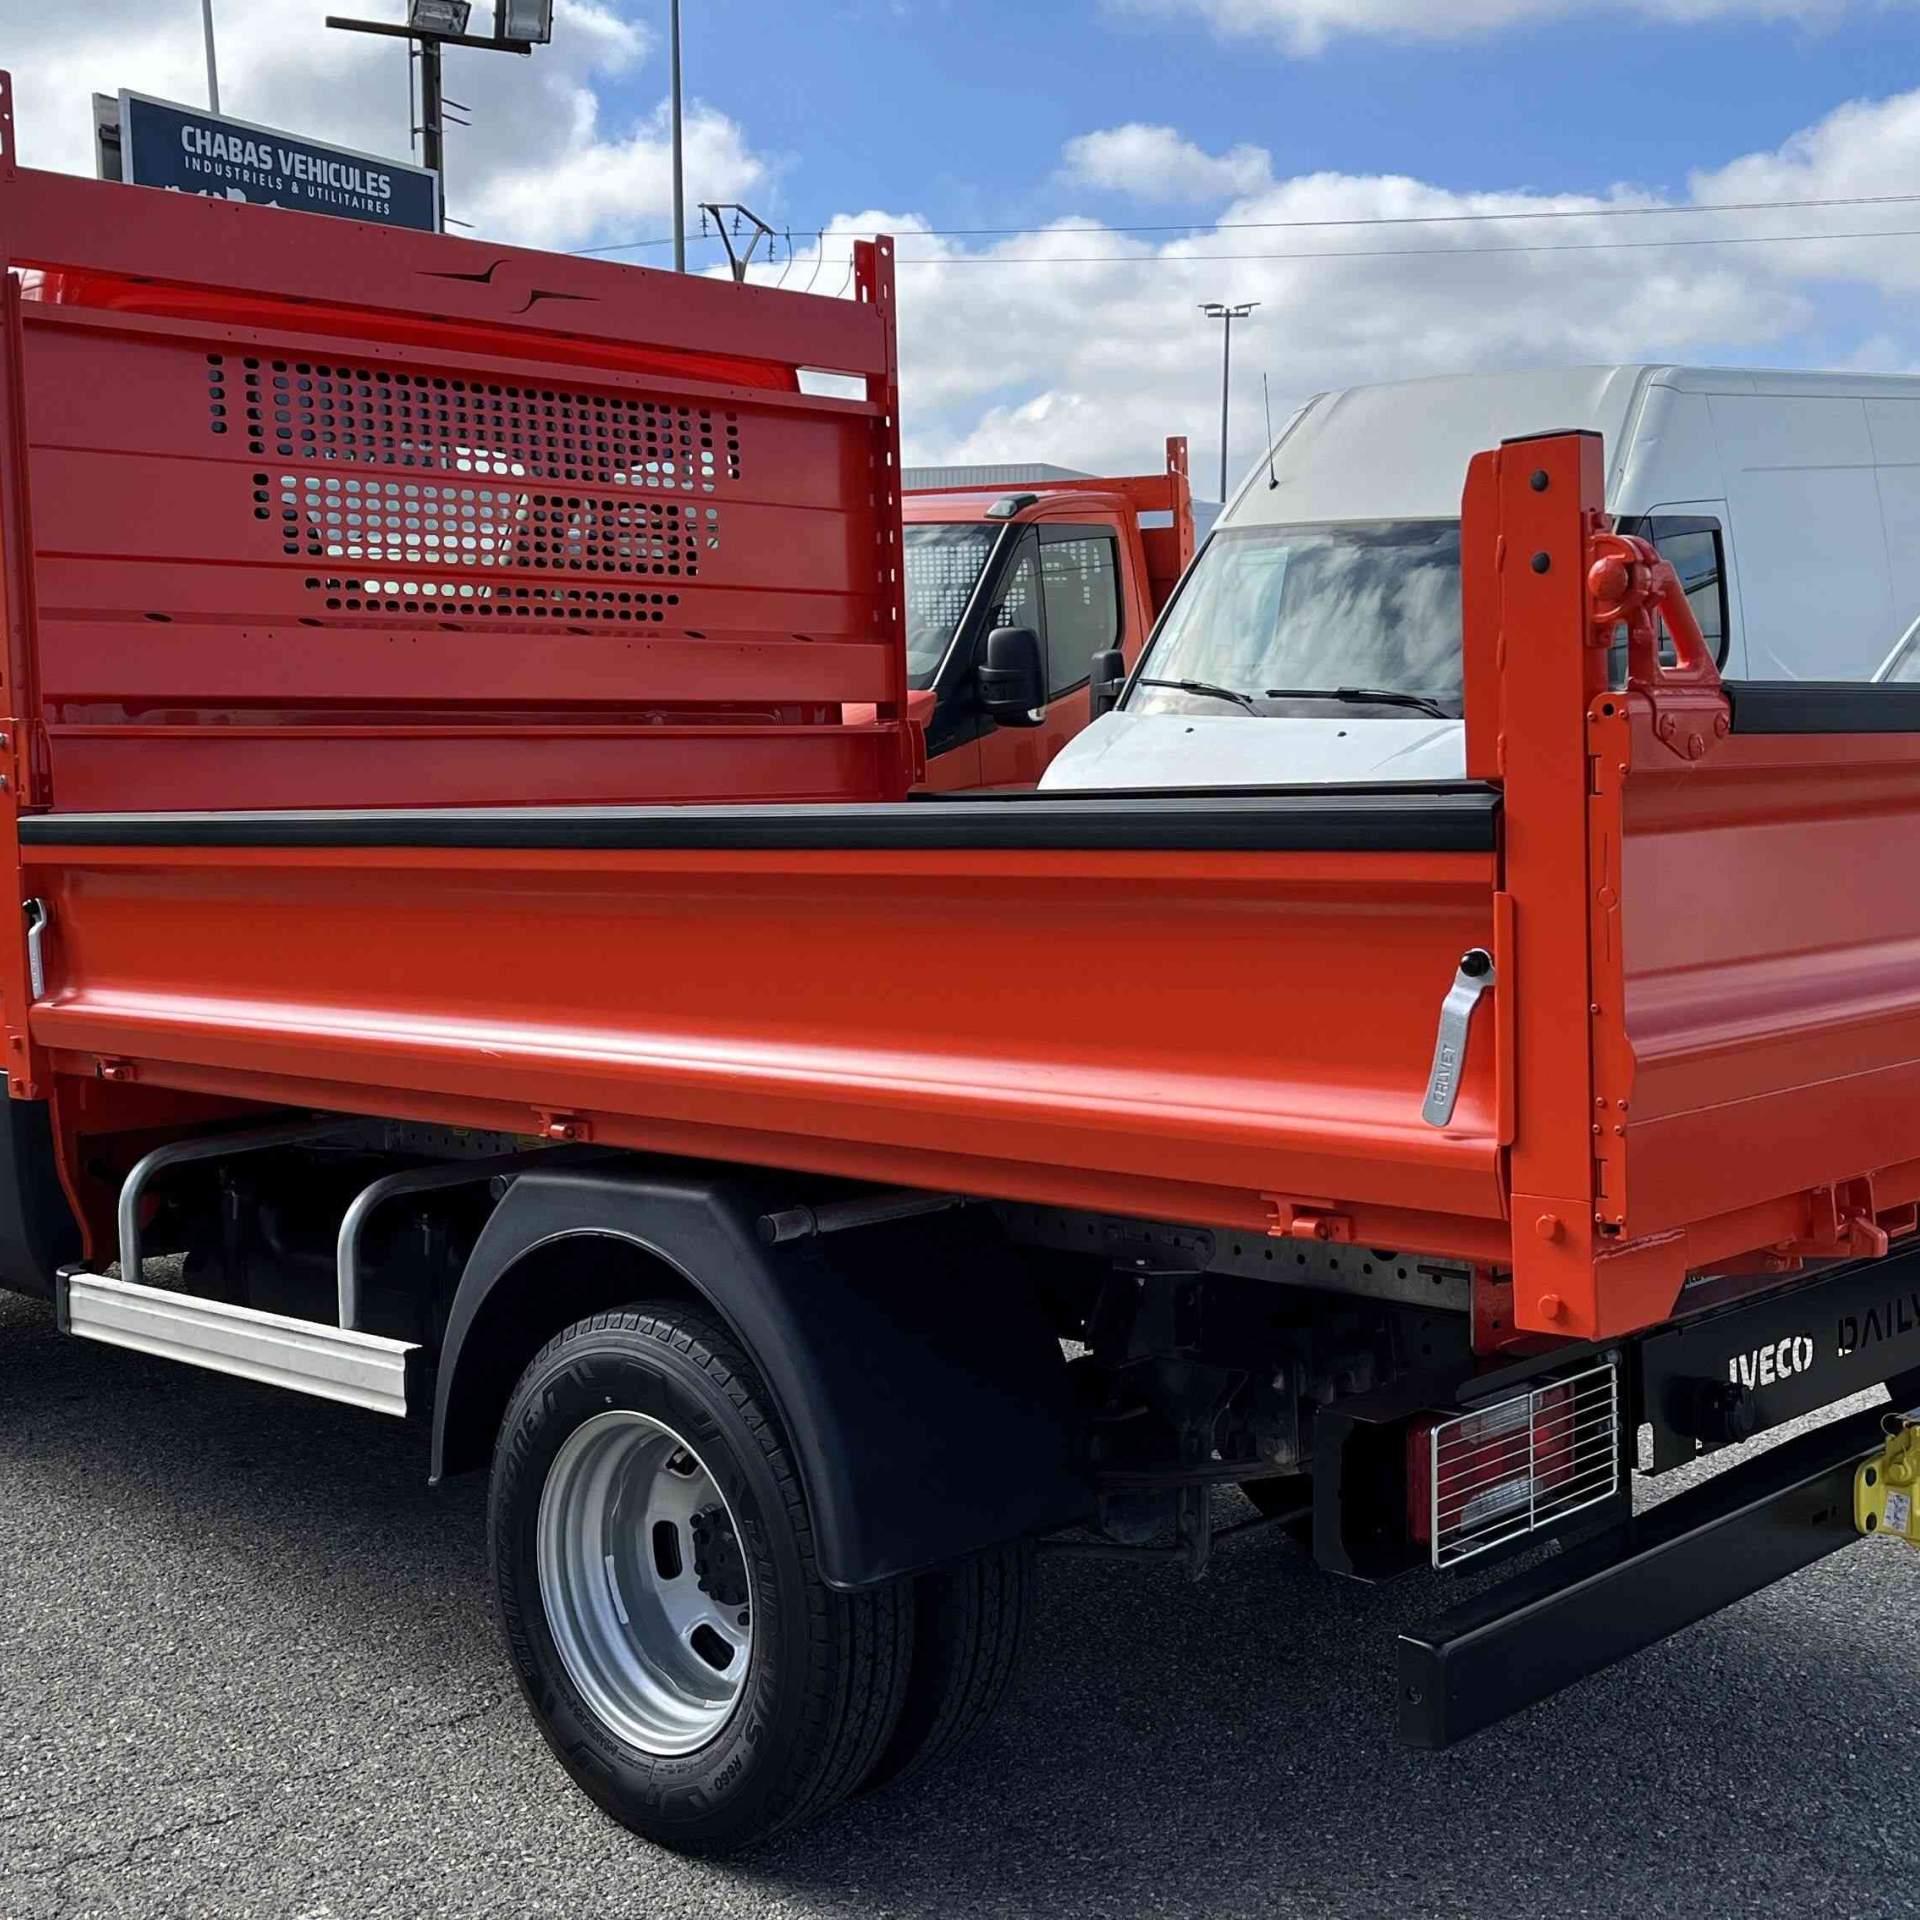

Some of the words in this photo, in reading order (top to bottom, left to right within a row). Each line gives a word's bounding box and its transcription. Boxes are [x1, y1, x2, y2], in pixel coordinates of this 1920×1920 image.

[181, 125, 273, 170] CHABAS
[278, 149, 391, 199] VEHICULES
[185, 155, 283, 190] INDUSTRIELS
[291, 181, 299, 194] &
[308, 185, 390, 215] UTILITAIRES
[1729, 1334, 1813, 1391] IVECO
[714, 1753, 743, 1790] R660
